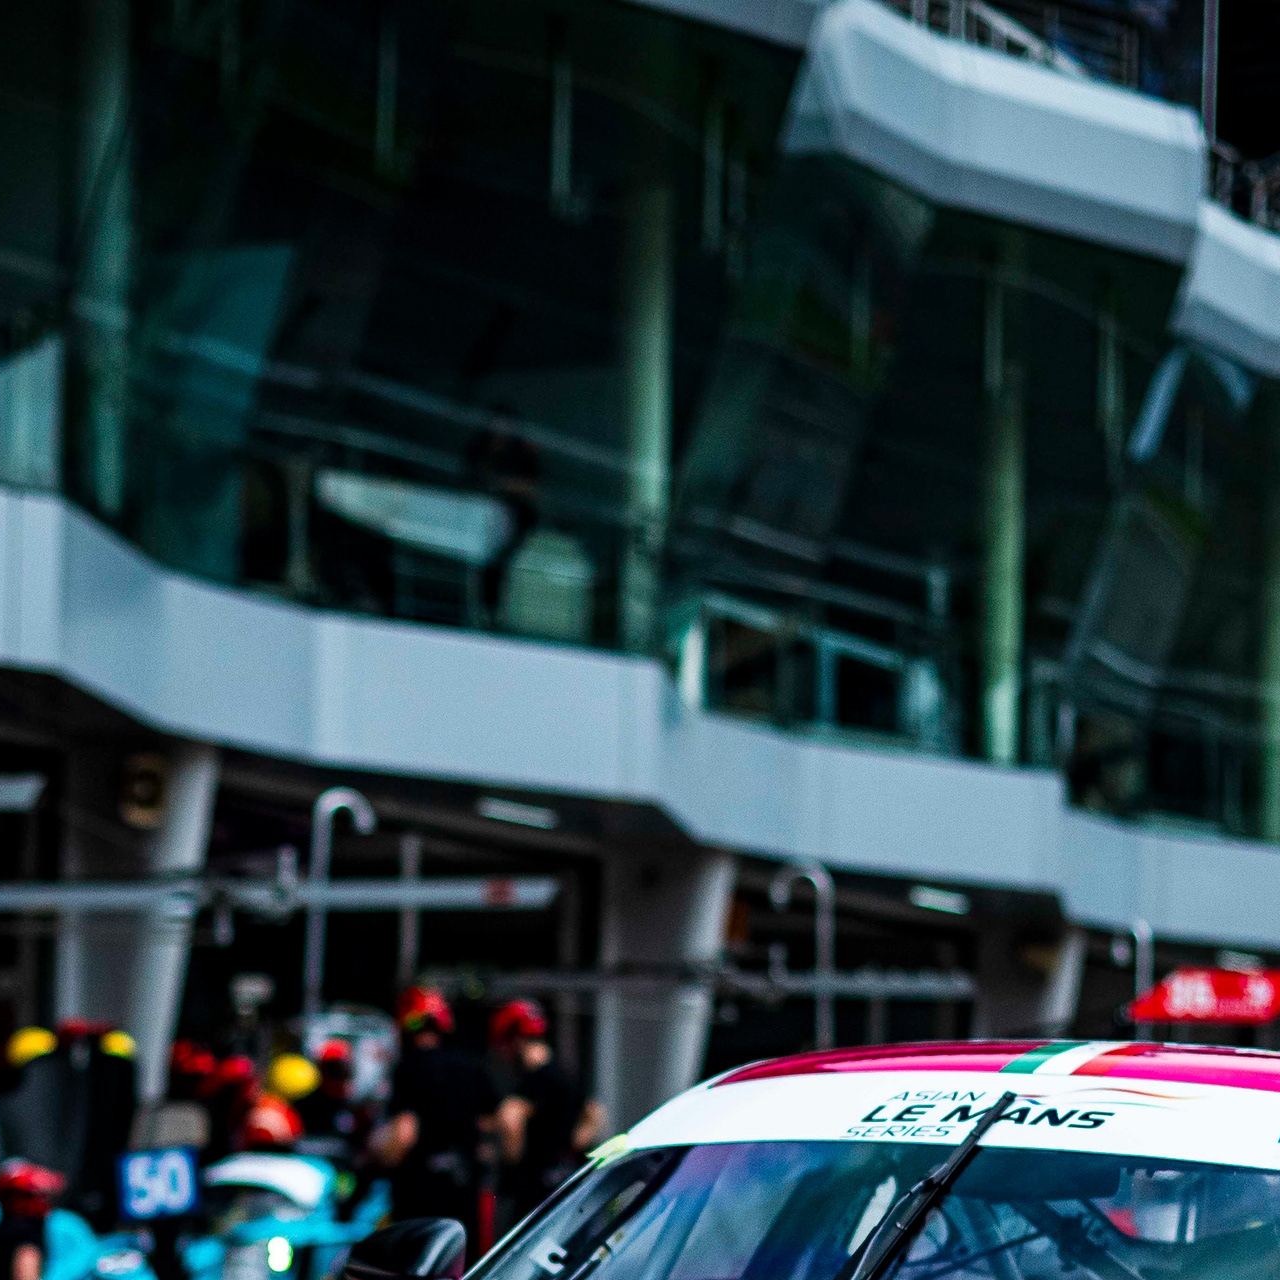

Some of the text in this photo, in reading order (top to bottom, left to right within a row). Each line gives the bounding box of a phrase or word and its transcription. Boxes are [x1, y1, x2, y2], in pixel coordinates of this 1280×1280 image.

[886, 1090, 986, 1102] ASIAN
[861, 1104, 1116, 1129] LE MANS
[840, 1125, 955, 1138] SERIES
[127, 1151, 191, 1214] 50
